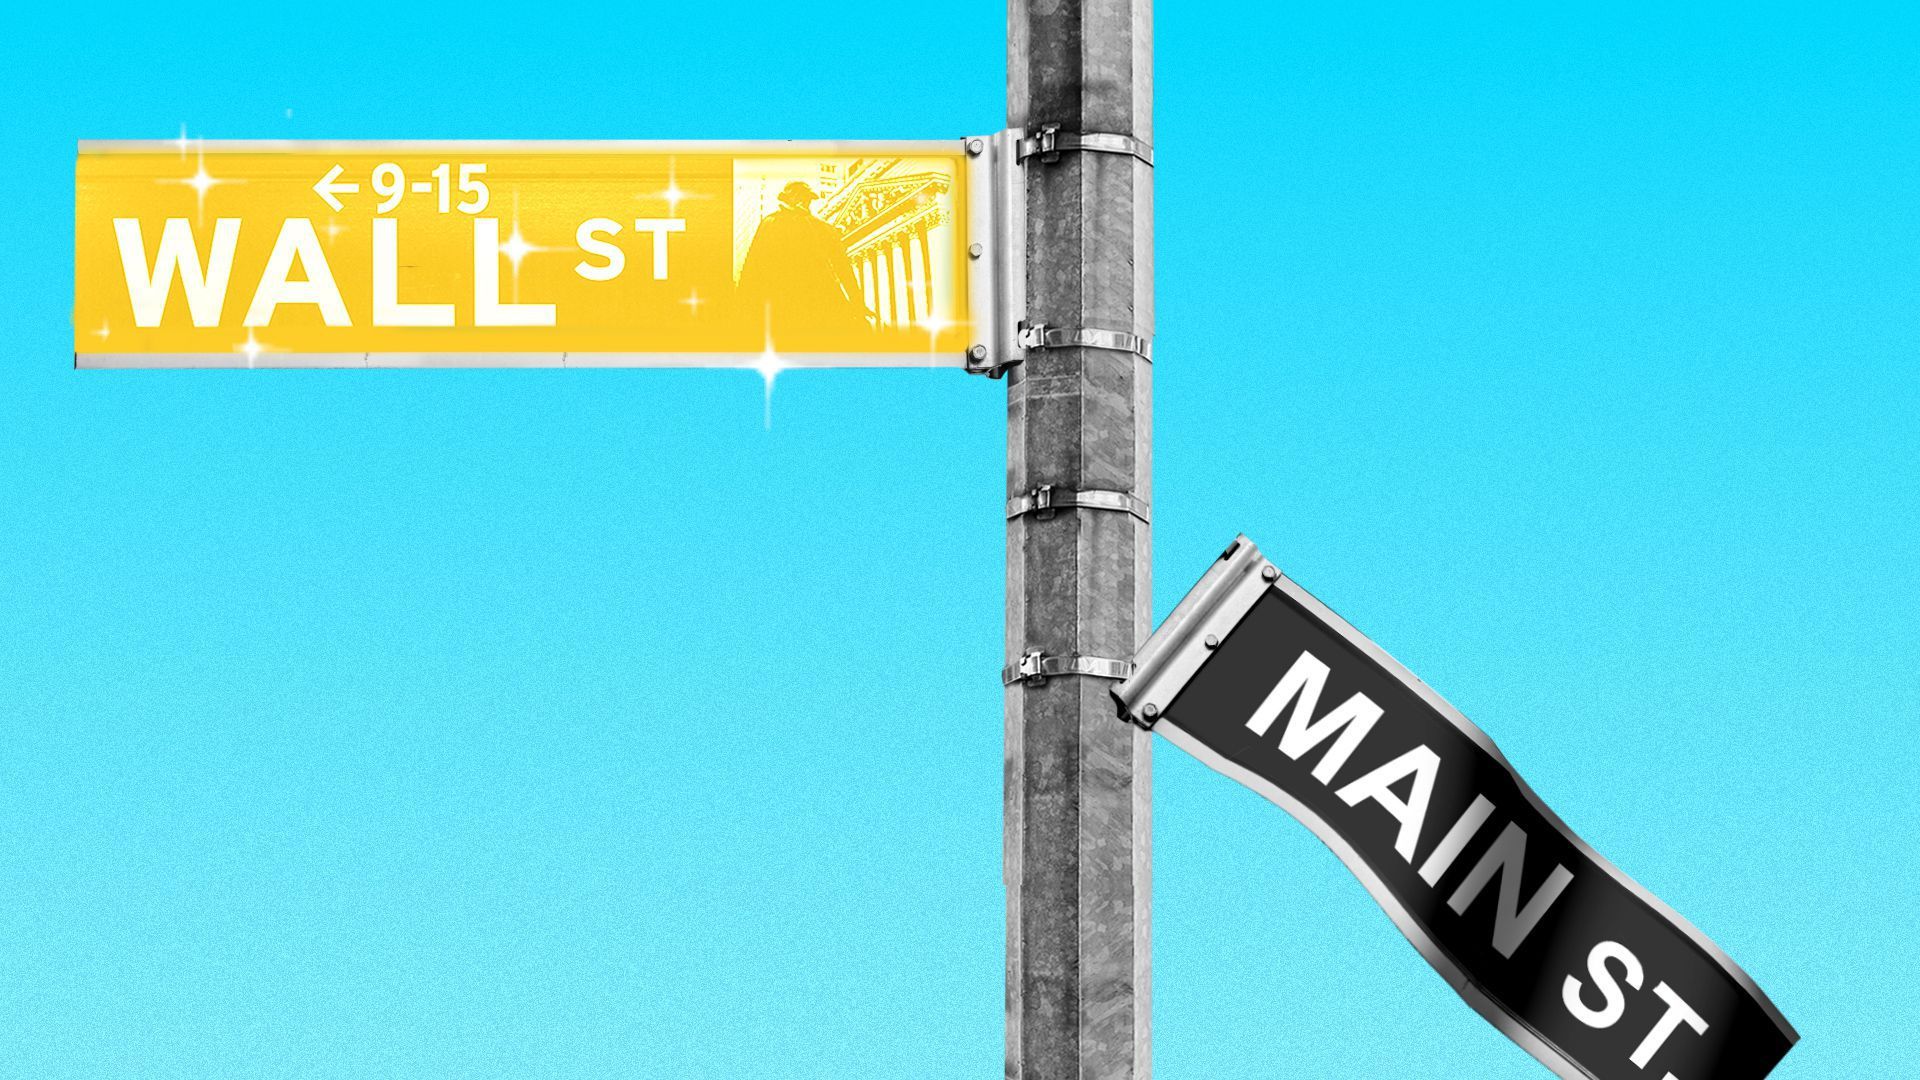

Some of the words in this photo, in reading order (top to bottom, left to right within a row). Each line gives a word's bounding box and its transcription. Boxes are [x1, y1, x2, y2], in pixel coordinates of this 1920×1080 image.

[372, 164, 489, 214] 9-15
[113, 217, 556, 327] WALL
[575, 218, 686, 281] ST
[1245, 650, 1575, 959] MAIN
[1562, 940, 1709, 1080] ST
